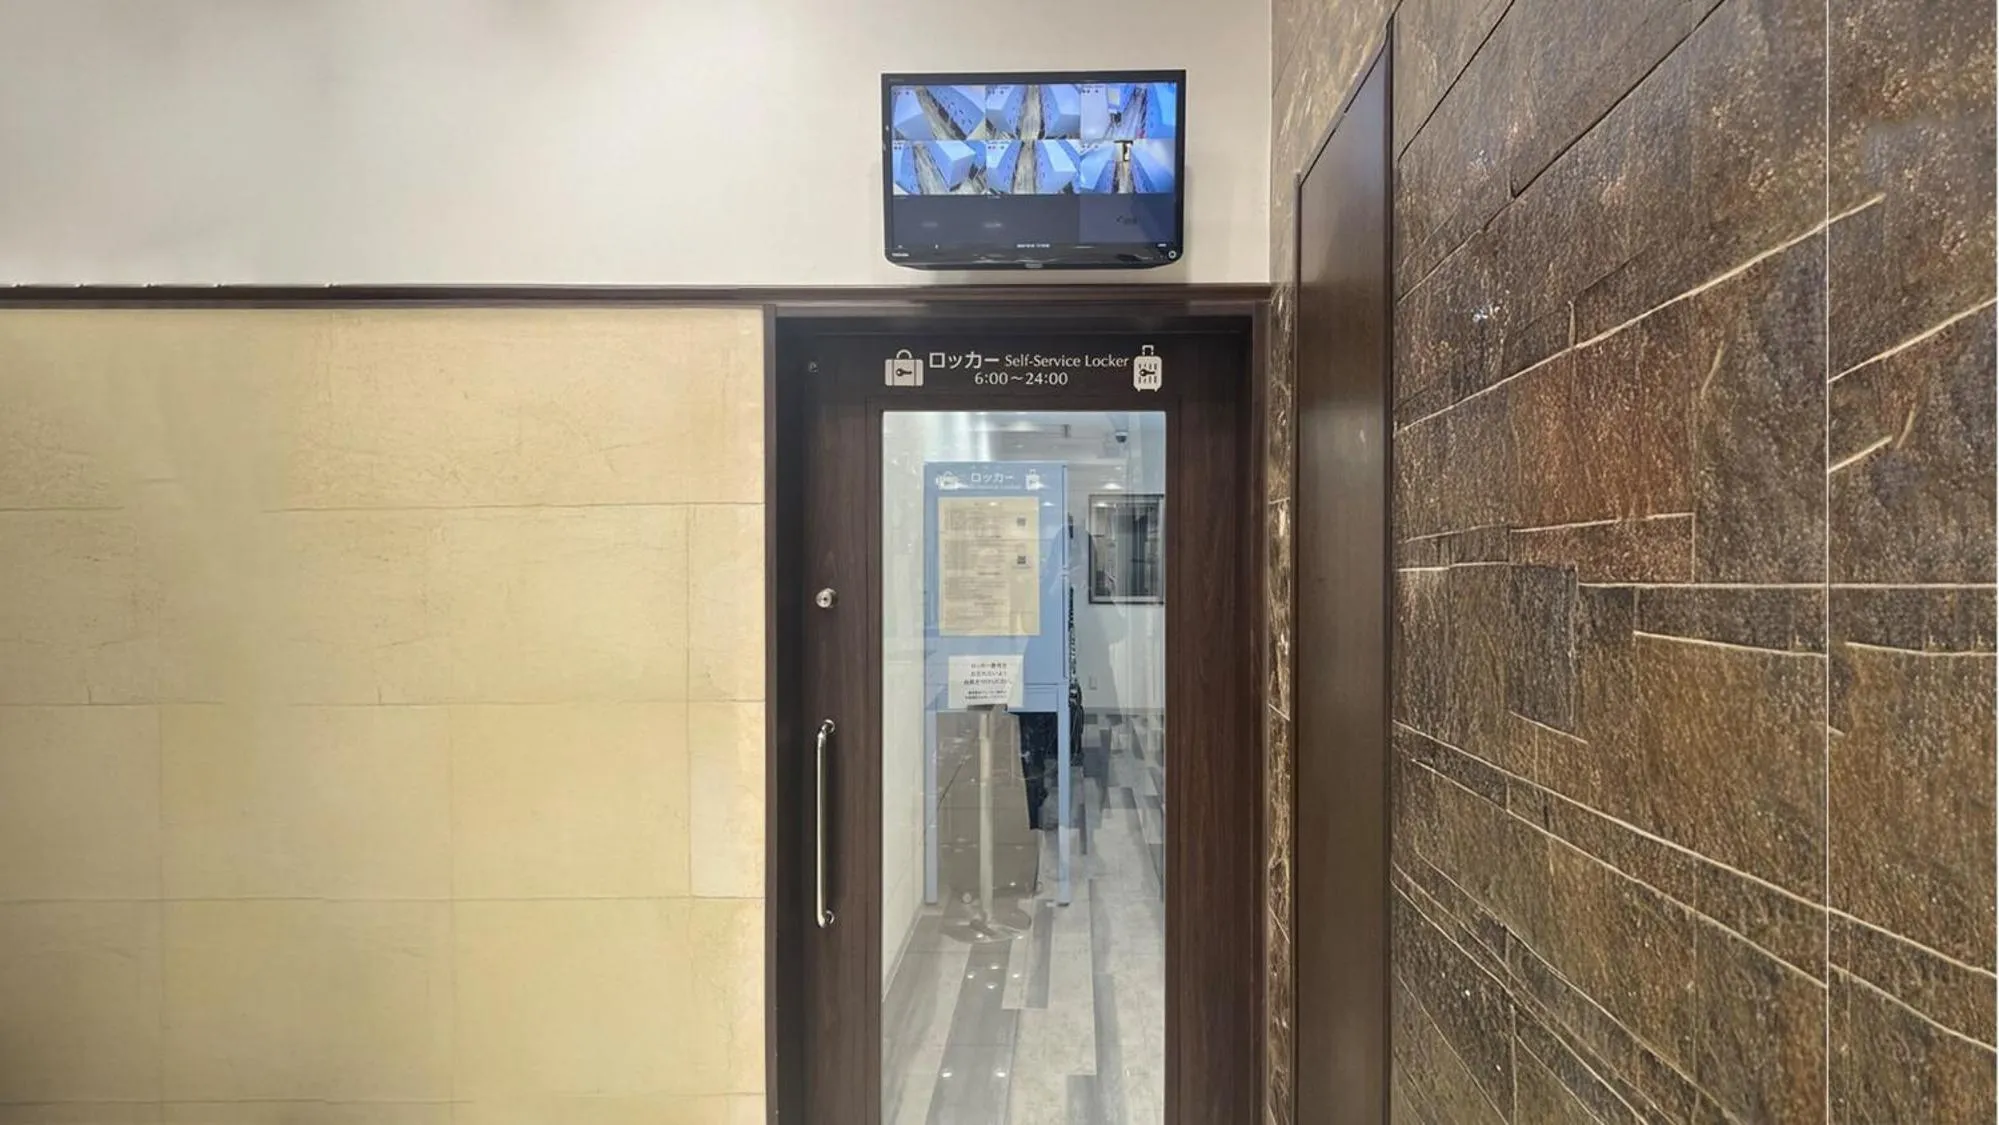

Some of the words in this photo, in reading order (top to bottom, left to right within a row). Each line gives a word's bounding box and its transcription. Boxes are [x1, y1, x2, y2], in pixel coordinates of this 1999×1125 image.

[929, 351, 1000, 369] ロッカー
[1005, 354, 1081, 367] Self-Service
[1085, 354, 1129, 367] Locker
[971, 472, 1014, 483] ロッカー
